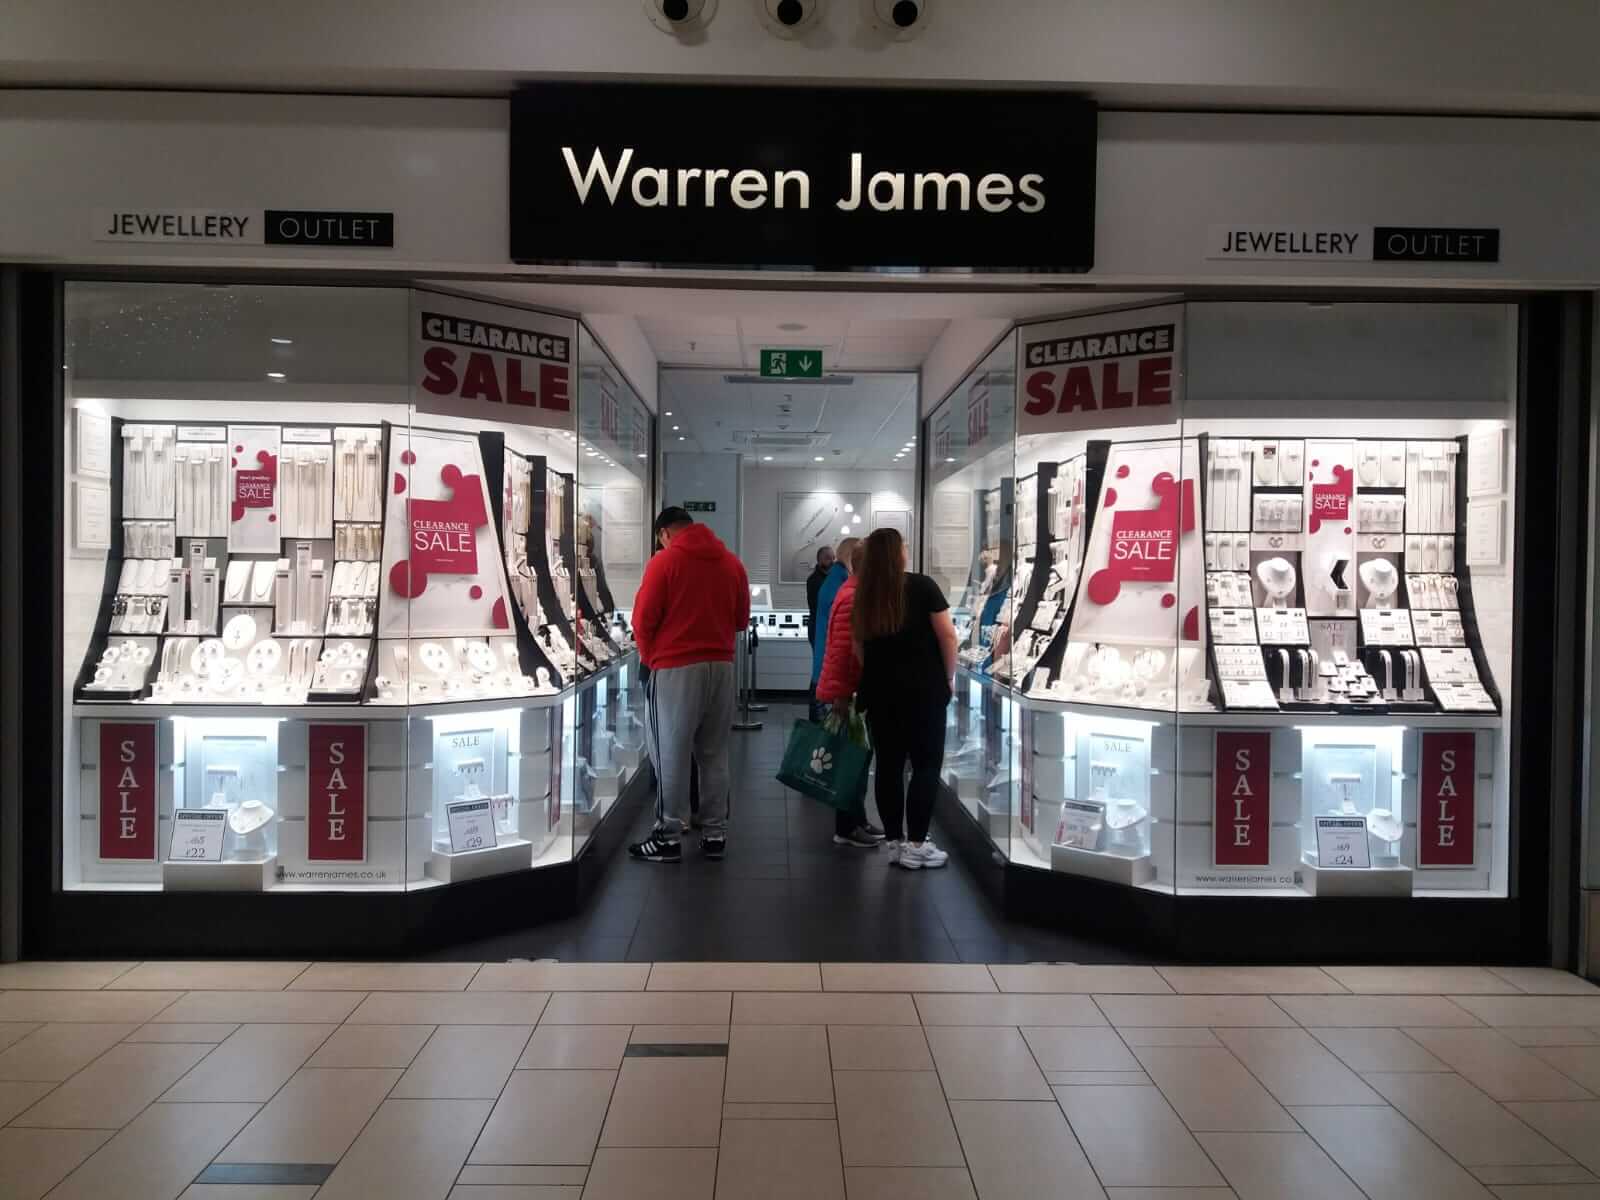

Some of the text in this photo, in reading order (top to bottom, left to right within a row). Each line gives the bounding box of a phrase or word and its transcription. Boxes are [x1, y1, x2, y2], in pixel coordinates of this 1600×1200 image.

[561, 146, 1046, 213] Warren James
[107, 213, 381, 240] JEWELLERY OUTLET
[1222, 231, 1486, 257] JEWELLERY OUTLET
[425, 317, 567, 360] CLEARANCE
[1028, 329, 1169, 365] CLEARANCE
[421, 346, 570, 412] SALE
[1023, 356, 1173, 416] SALE
[239, 488, 272, 499] SALE
[1314, 500, 1347, 510] SALE
[413, 519, 470, 531] CLEARANCE
[1115, 529, 1173, 539] CLEARANCE
[415, 531, 472, 553] SALE
[1113, 540, 1173, 560] SALE
[451, 735, 481, 749] SALE
[1103, 741, 1132, 753] SALE
[117, 740, 140, 839] SALE
[325, 742, 348, 841] SALE
[1231, 749, 1254, 846] SALE
[1436, 750, 1458, 847] SALE
